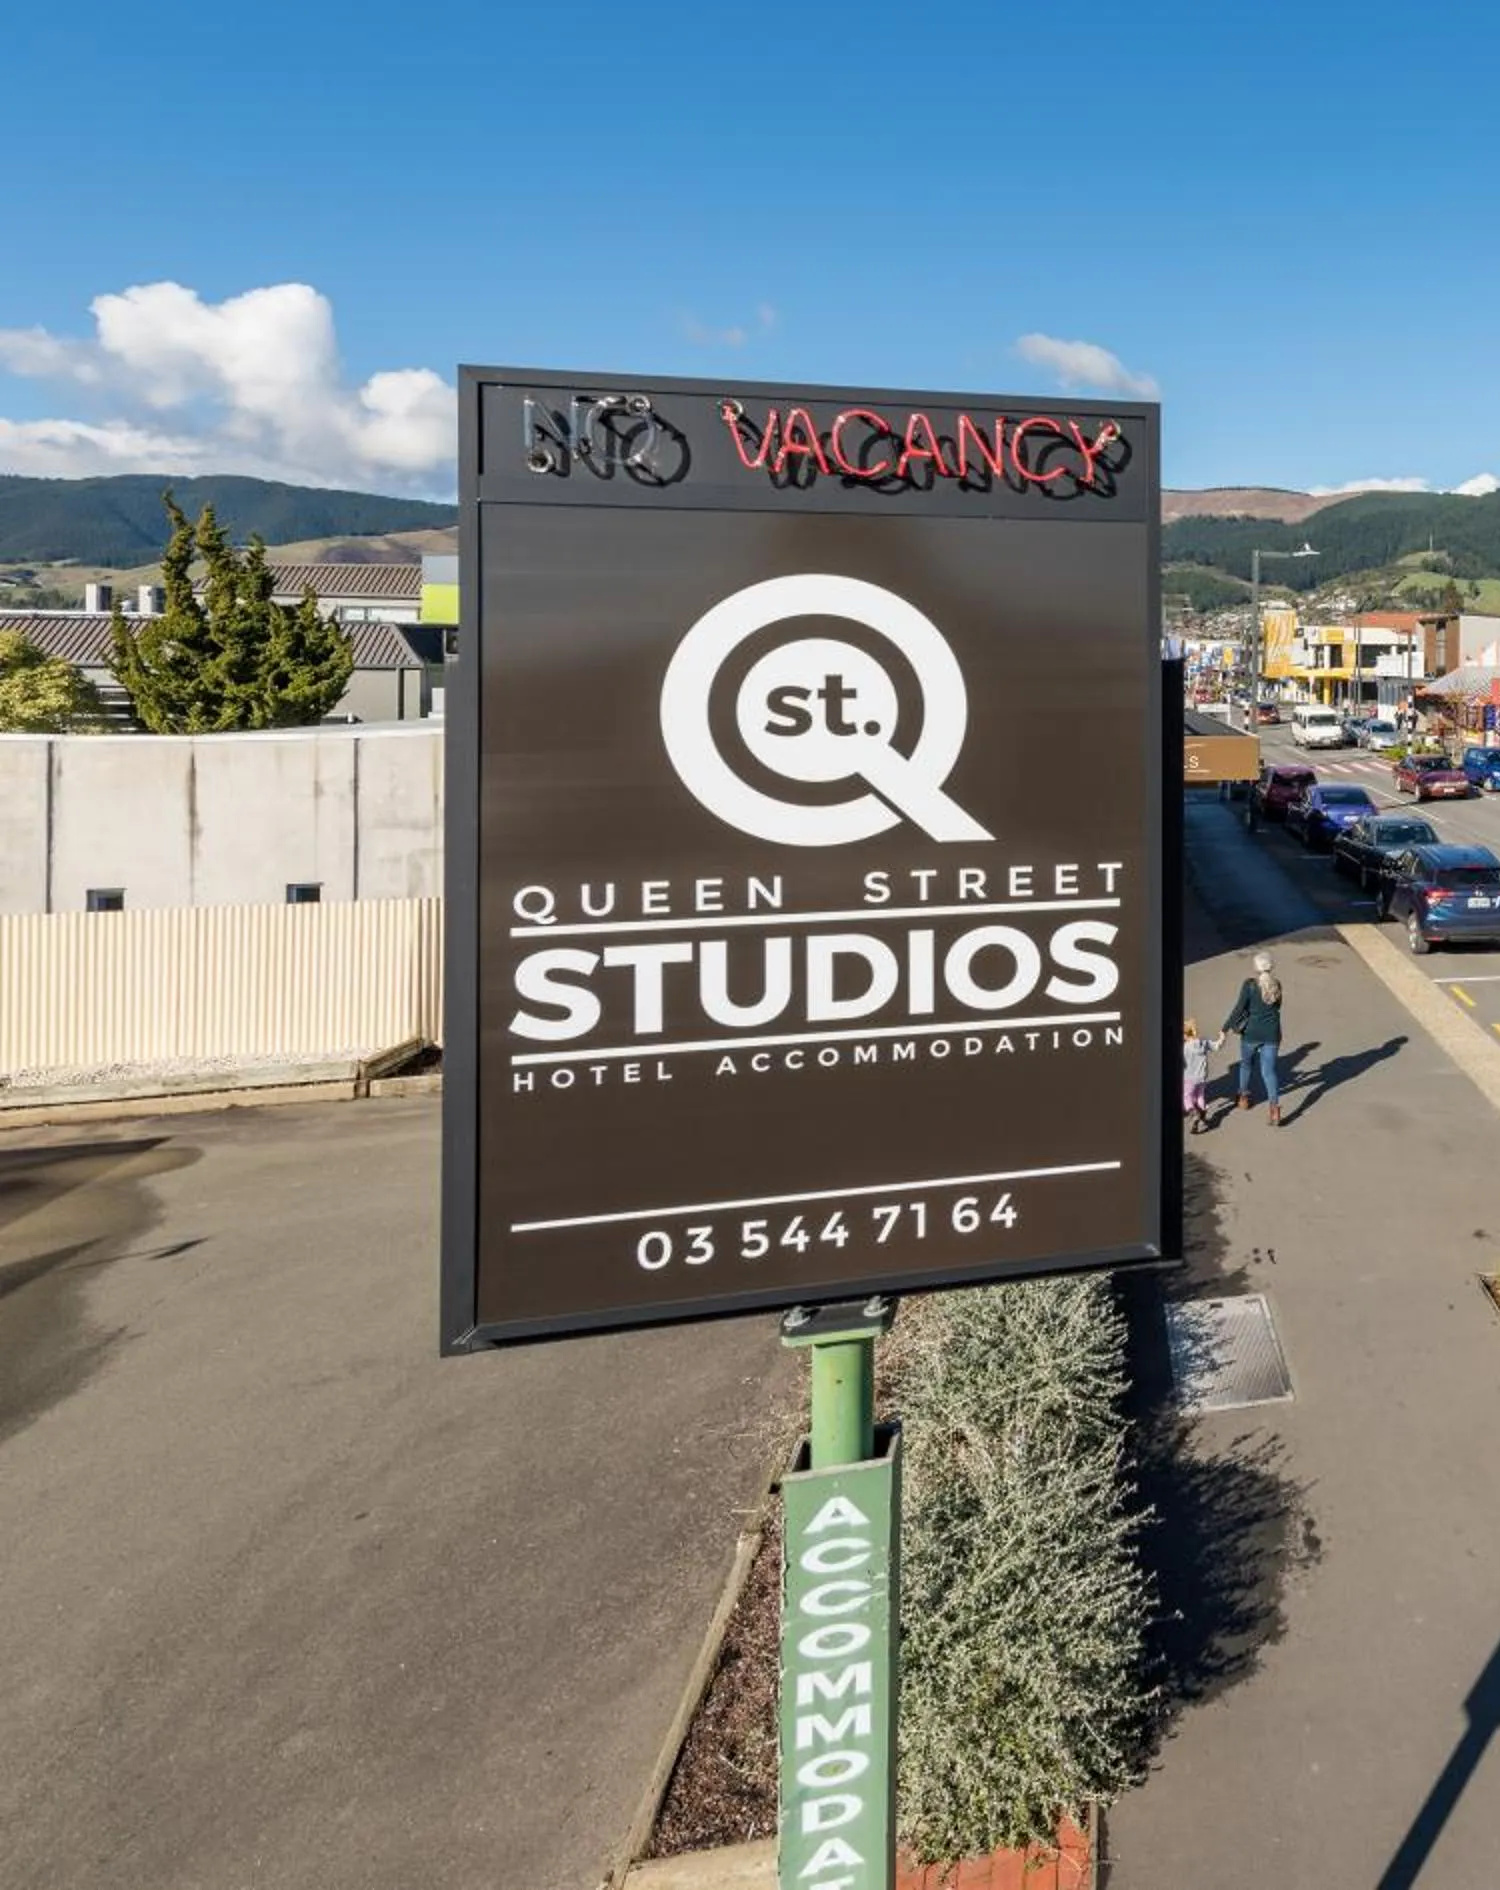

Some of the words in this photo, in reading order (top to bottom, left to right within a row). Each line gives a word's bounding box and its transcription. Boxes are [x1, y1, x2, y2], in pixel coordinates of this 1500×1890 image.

[523, 394, 659, 474] NO
[720, 399, 1121, 483] VACANCY
[764, 674, 881, 737] st.
[512, 874, 783, 926] QUEEN
[863, 861, 1123, 903] STREET
[508, 920, 1119, 1041] STUDIOS
[513, 1060, 673, 1093] HOTEL
[715, 1026, 1123, 1075] ACCOMMODATION
[637, 1225, 715, 1270] 03
[741, 1211, 849, 1258] 544
[872, 1202, 926, 1243] 71
[951, 1193, 1018, 1233] 64
